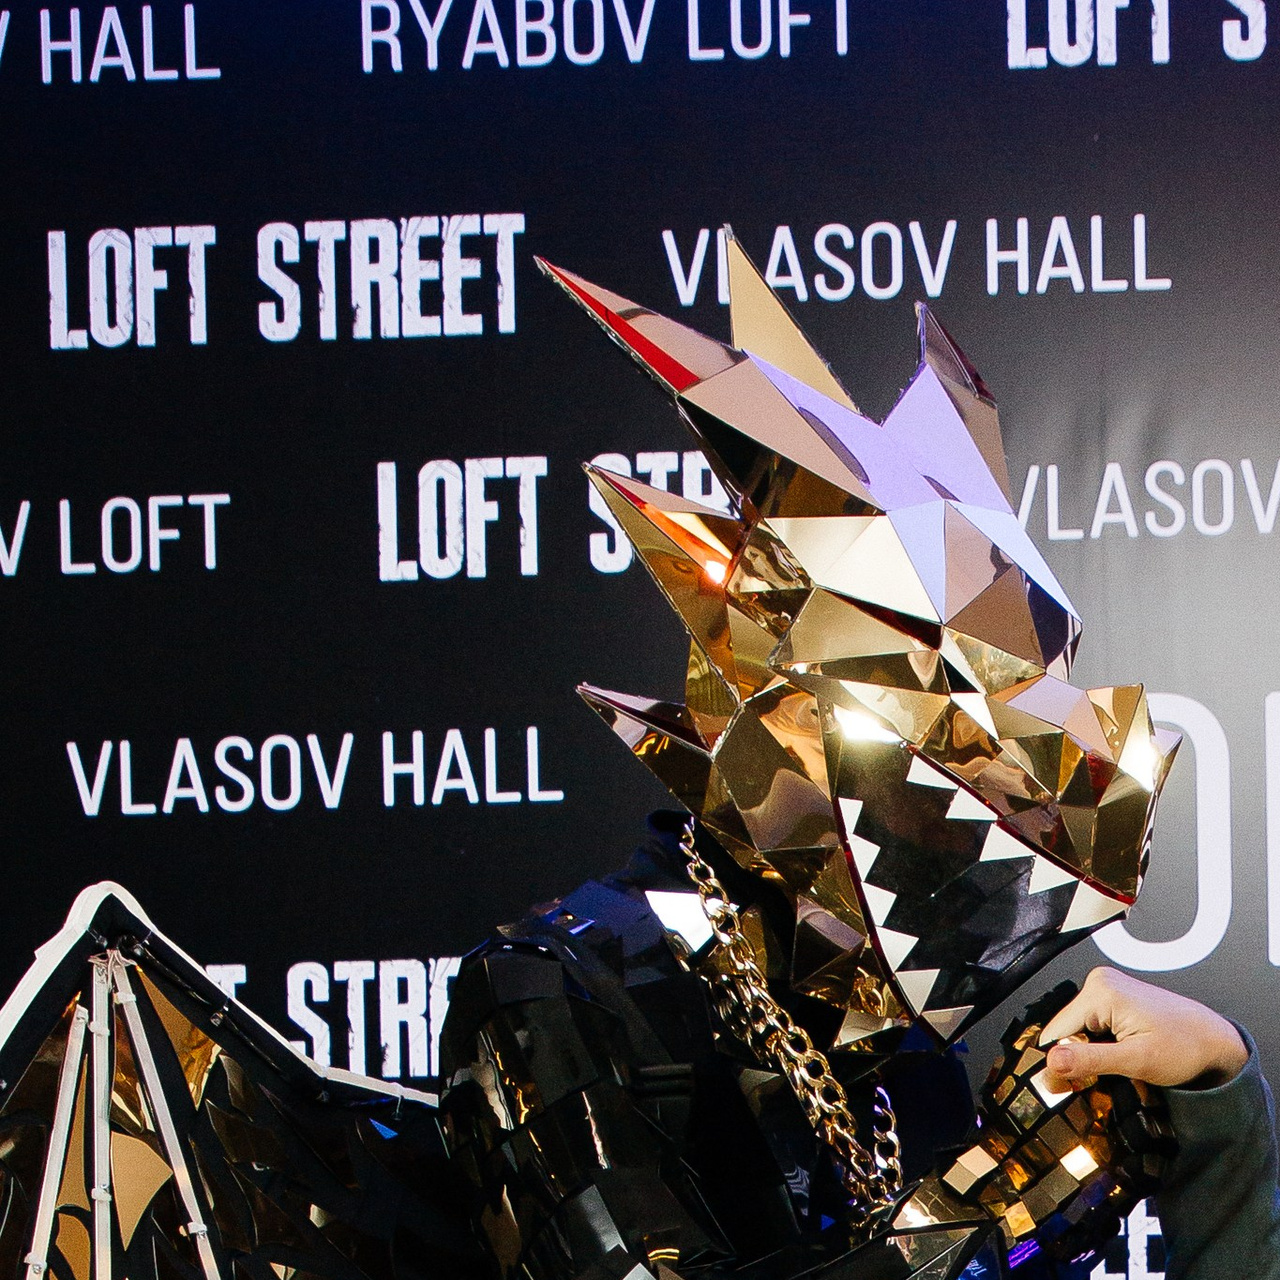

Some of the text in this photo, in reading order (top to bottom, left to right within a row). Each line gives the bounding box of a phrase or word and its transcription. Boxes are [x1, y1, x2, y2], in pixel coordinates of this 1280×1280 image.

[40, 3, 222, 84] HALL
[361, 0, 656, 73] RYABOV
[47, 212, 526, 350] LOFT STREET
[985, 213, 1173, 297] HALL
[59, 493, 231, 575] LOFT
[376, 455, 548, 582] LOFT
[66, 726, 565, 817] VLASOV HALL
